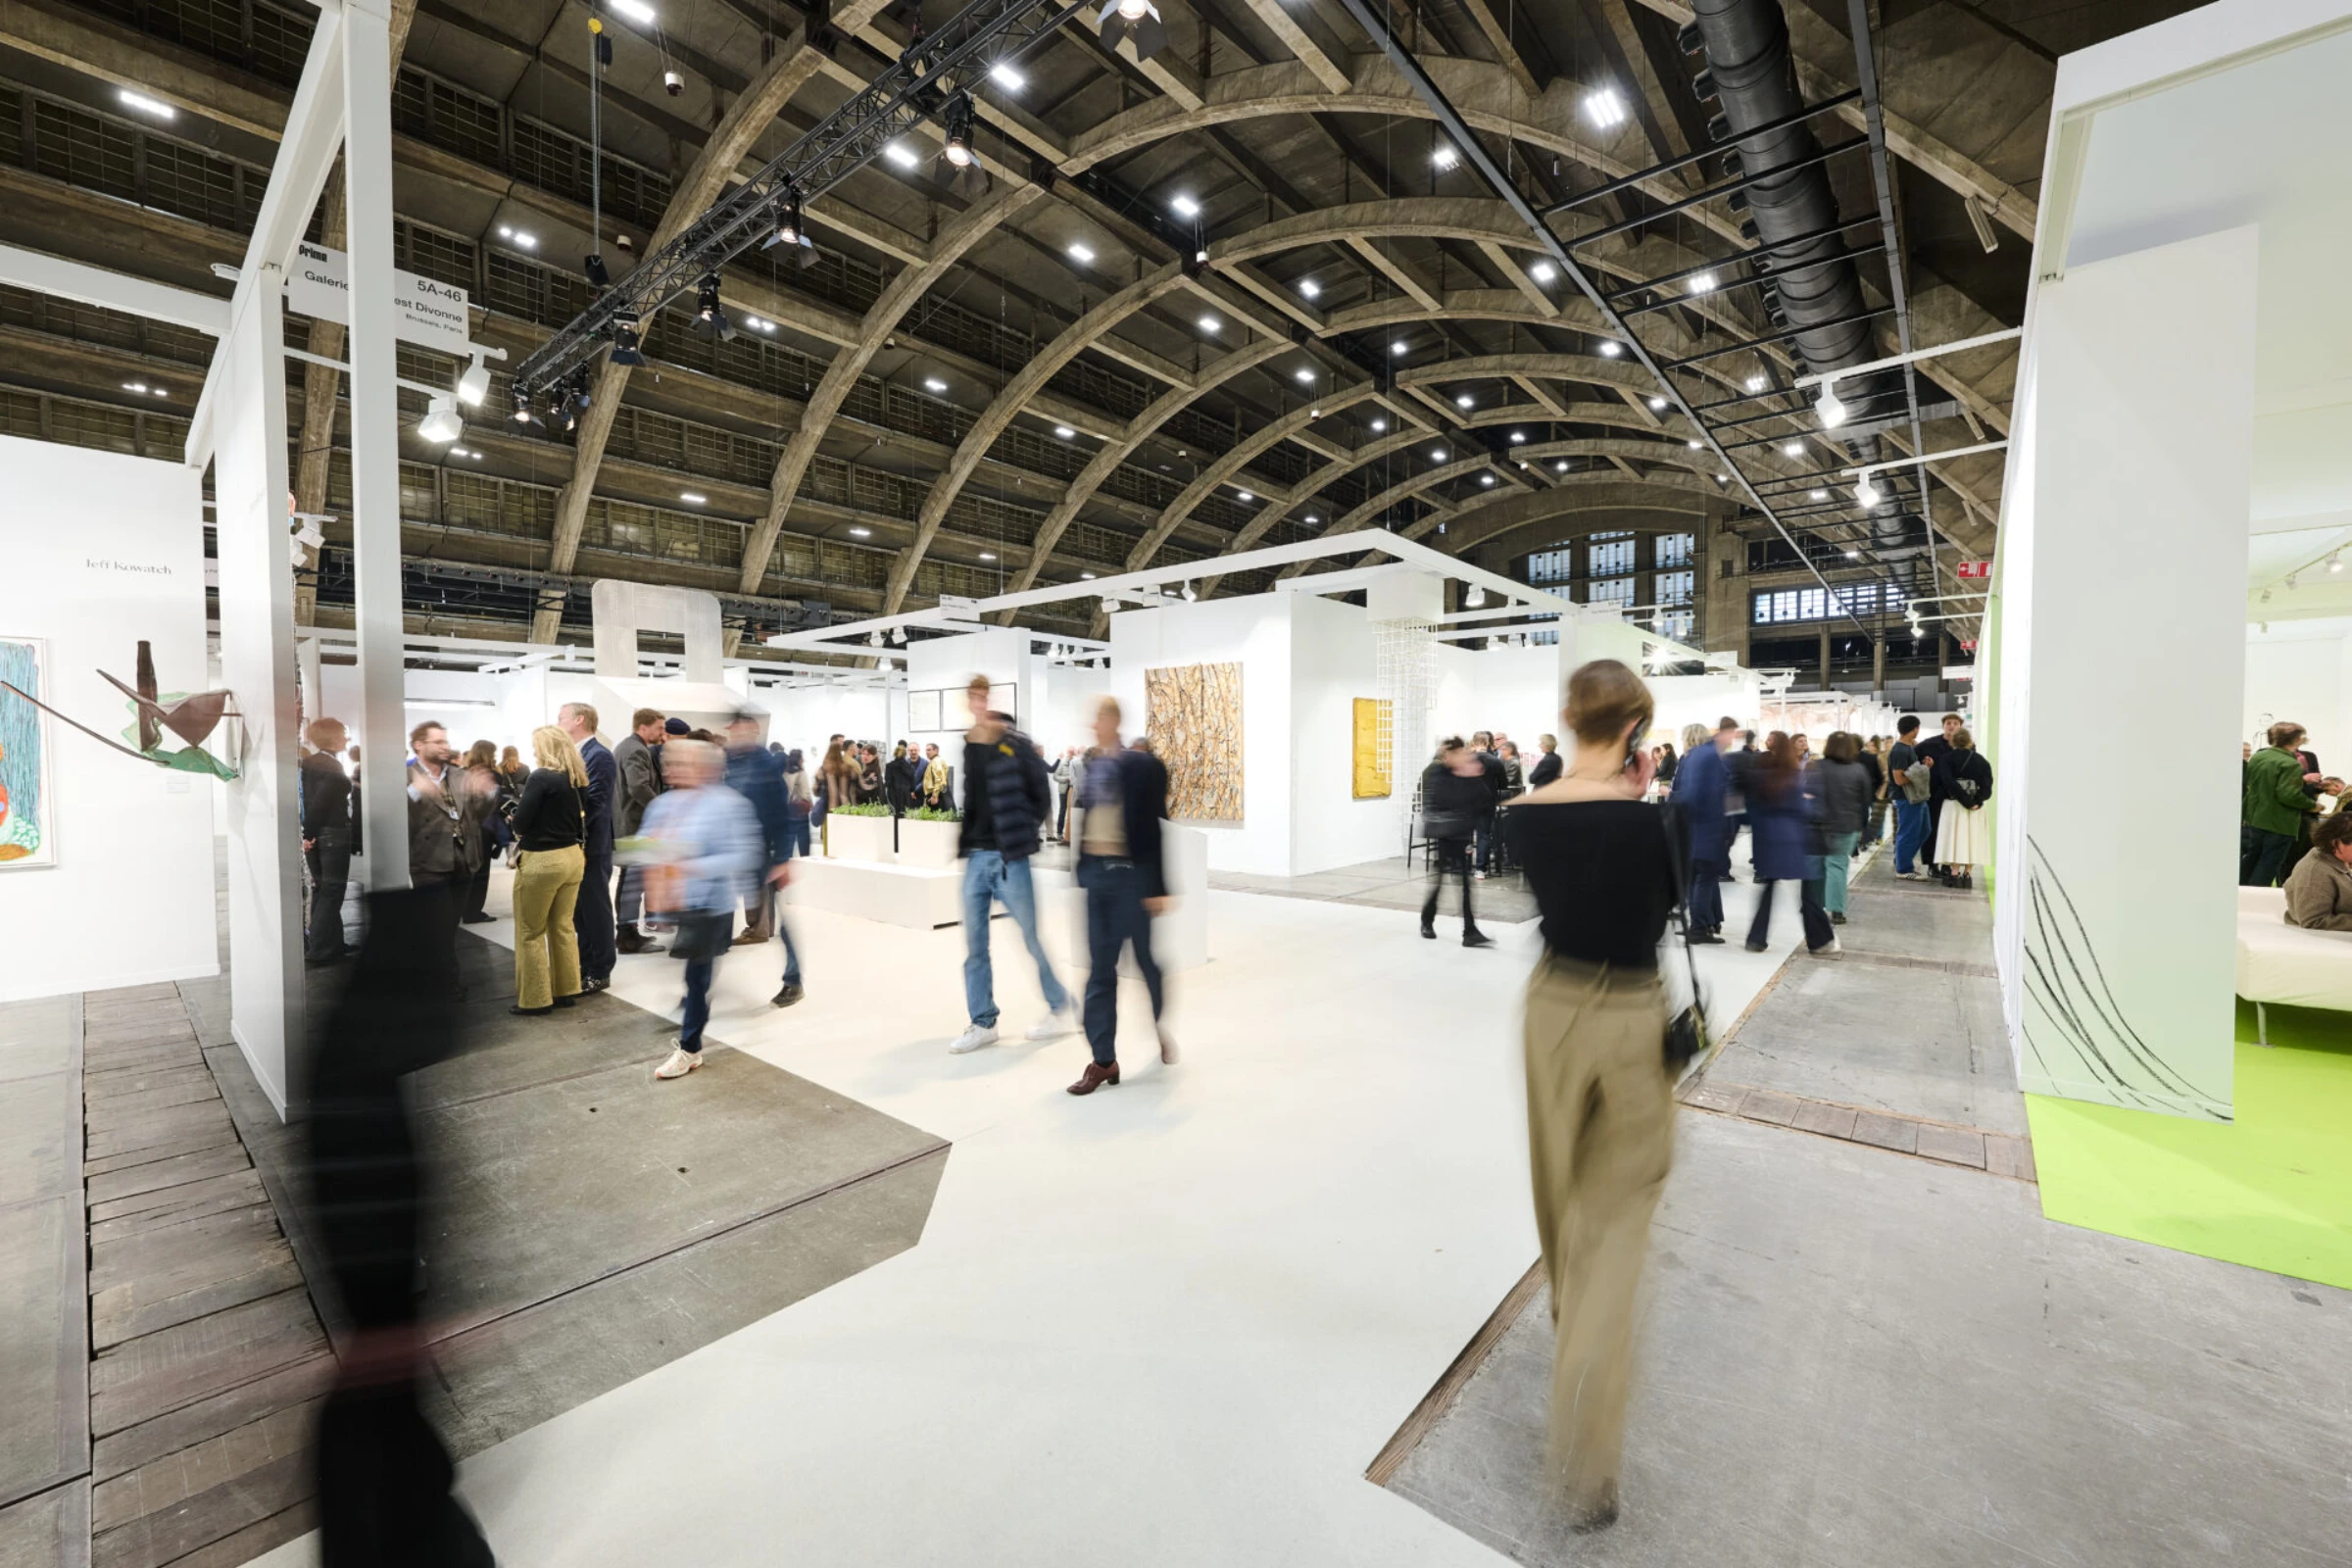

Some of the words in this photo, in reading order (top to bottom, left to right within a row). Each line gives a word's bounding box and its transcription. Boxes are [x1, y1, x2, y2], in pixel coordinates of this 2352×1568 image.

[417, 280, 462, 302] 5A-46
[394, 298, 413, 309] est
[416, 302, 463, 322] Divonne
[443, 323, 464, 334] Paris
[114, 561, 172, 574] Kowatch
